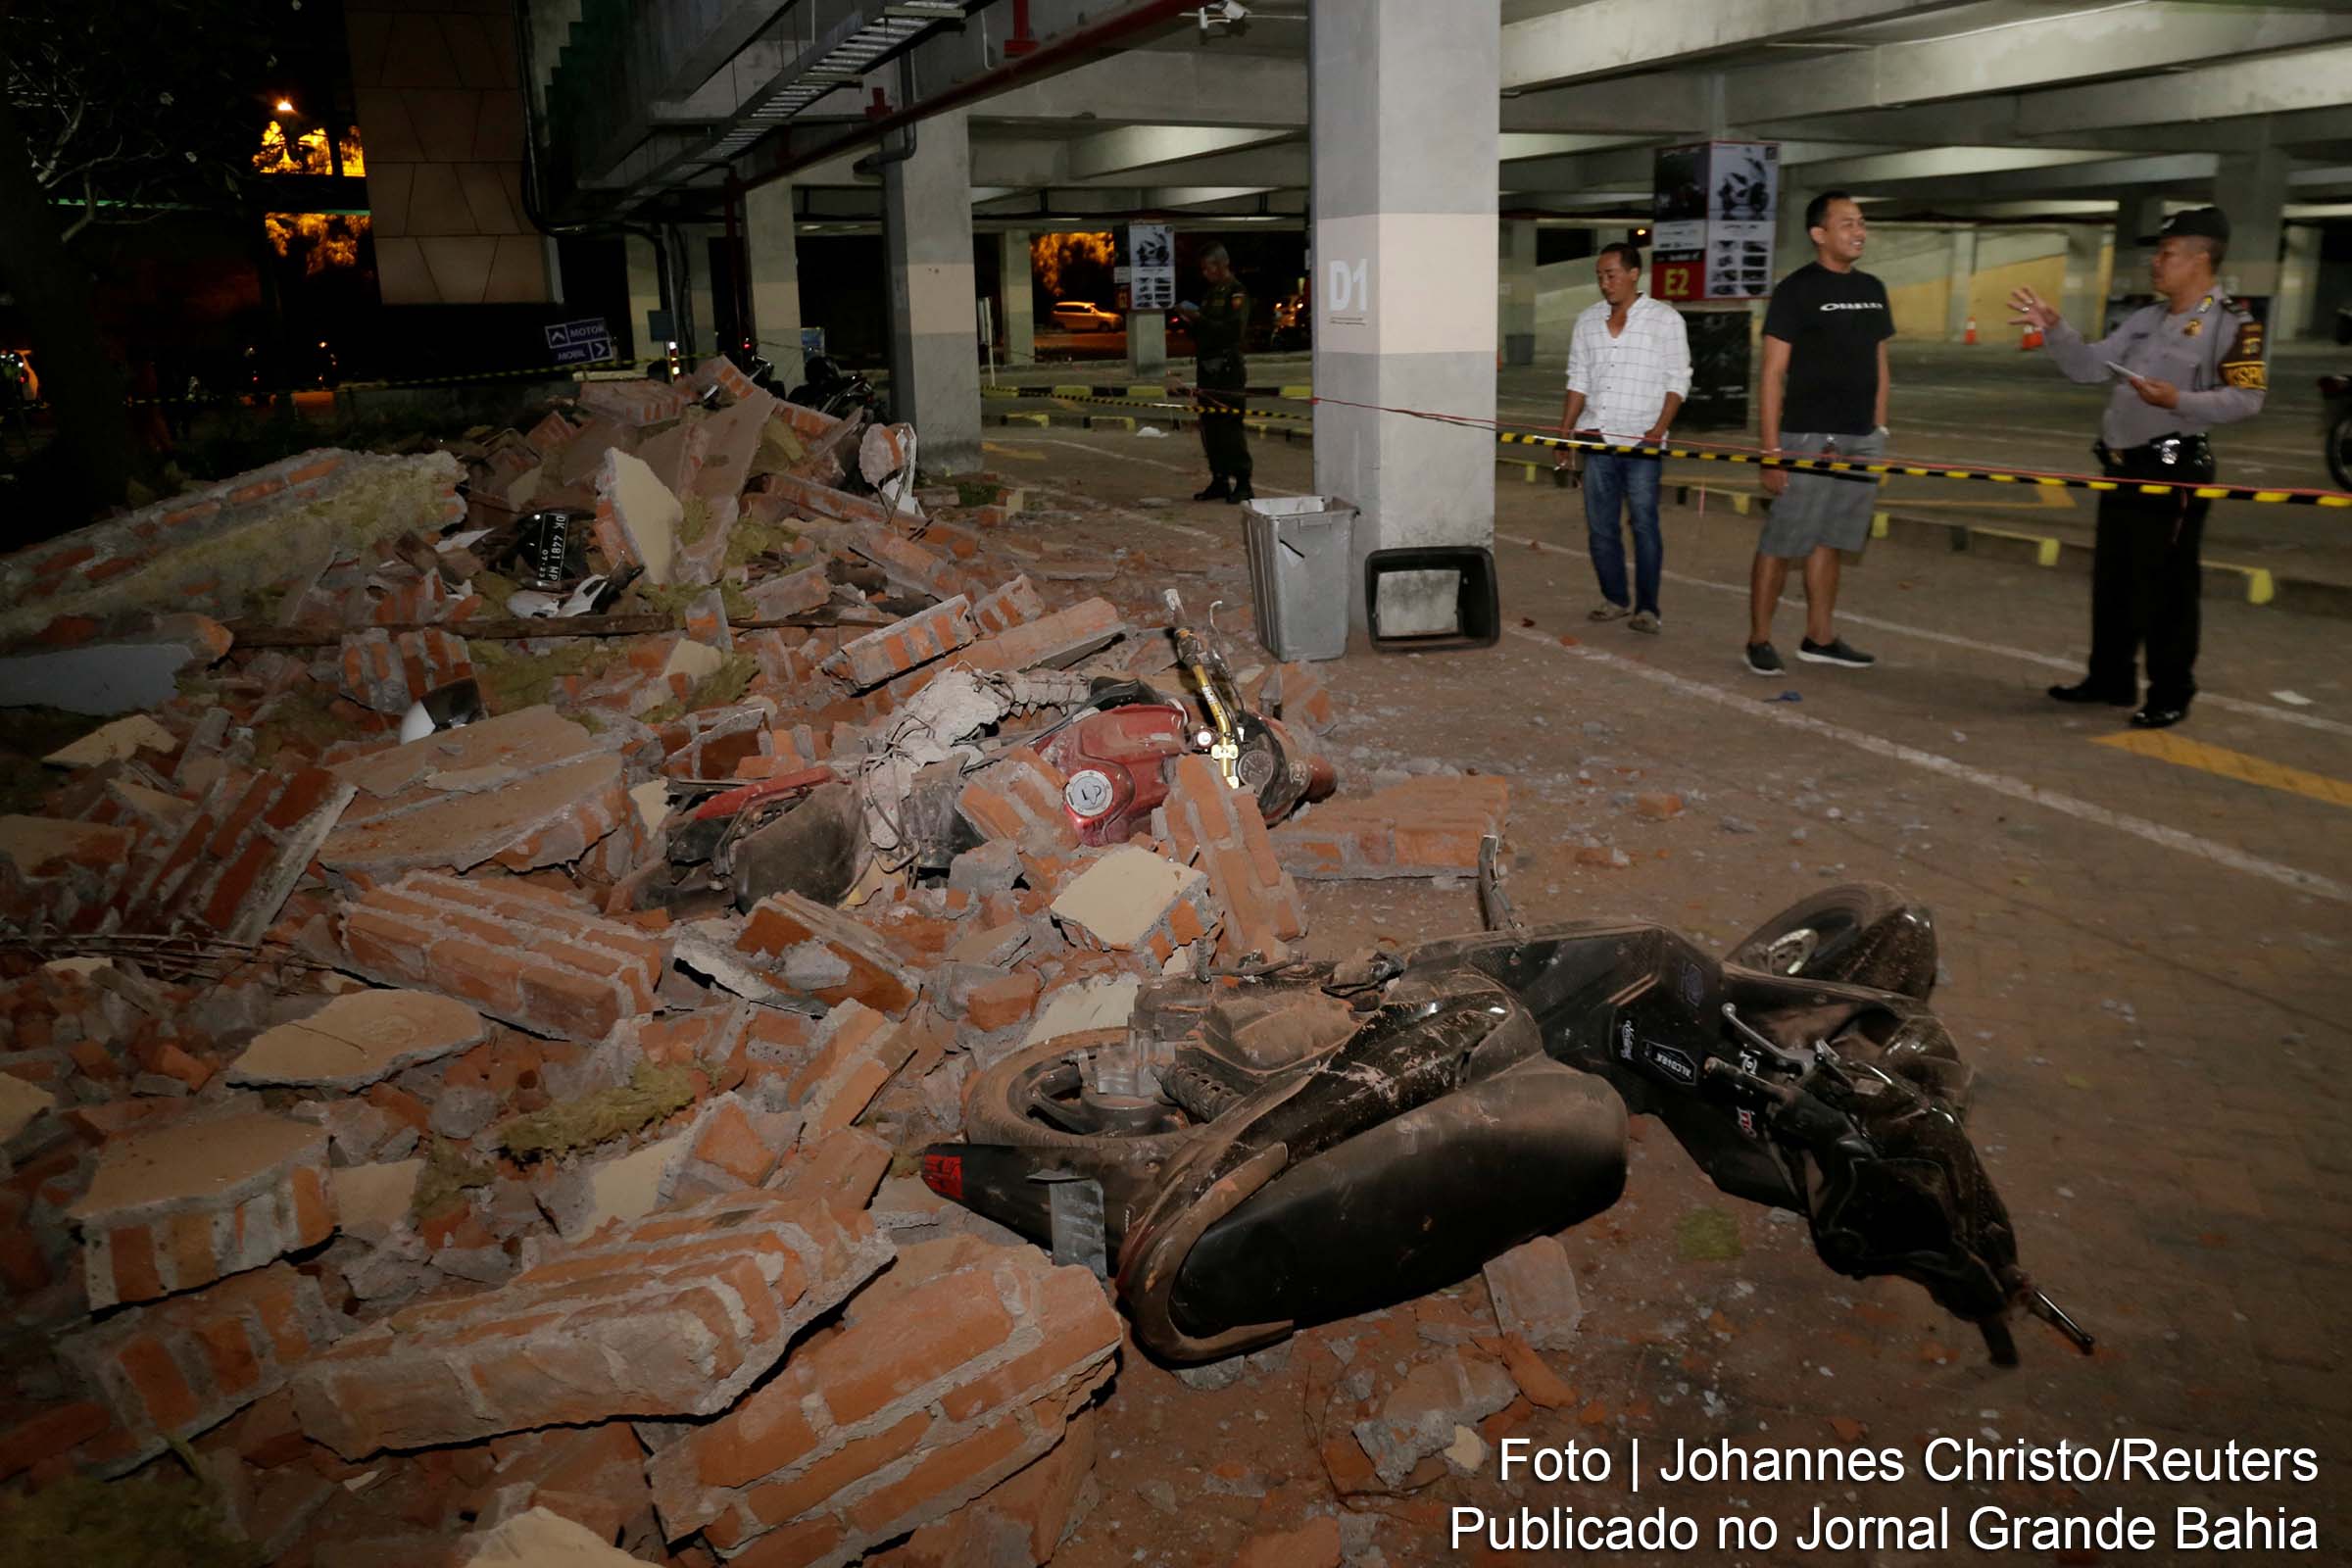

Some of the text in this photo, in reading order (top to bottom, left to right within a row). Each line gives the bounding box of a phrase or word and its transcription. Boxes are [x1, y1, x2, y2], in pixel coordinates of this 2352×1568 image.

[1329, 260, 1368, 313] D1
[1664, 268, 1690, 297] E2
[553, 514, 566, 530] DK
[550, 534, 564, 560] 4481
